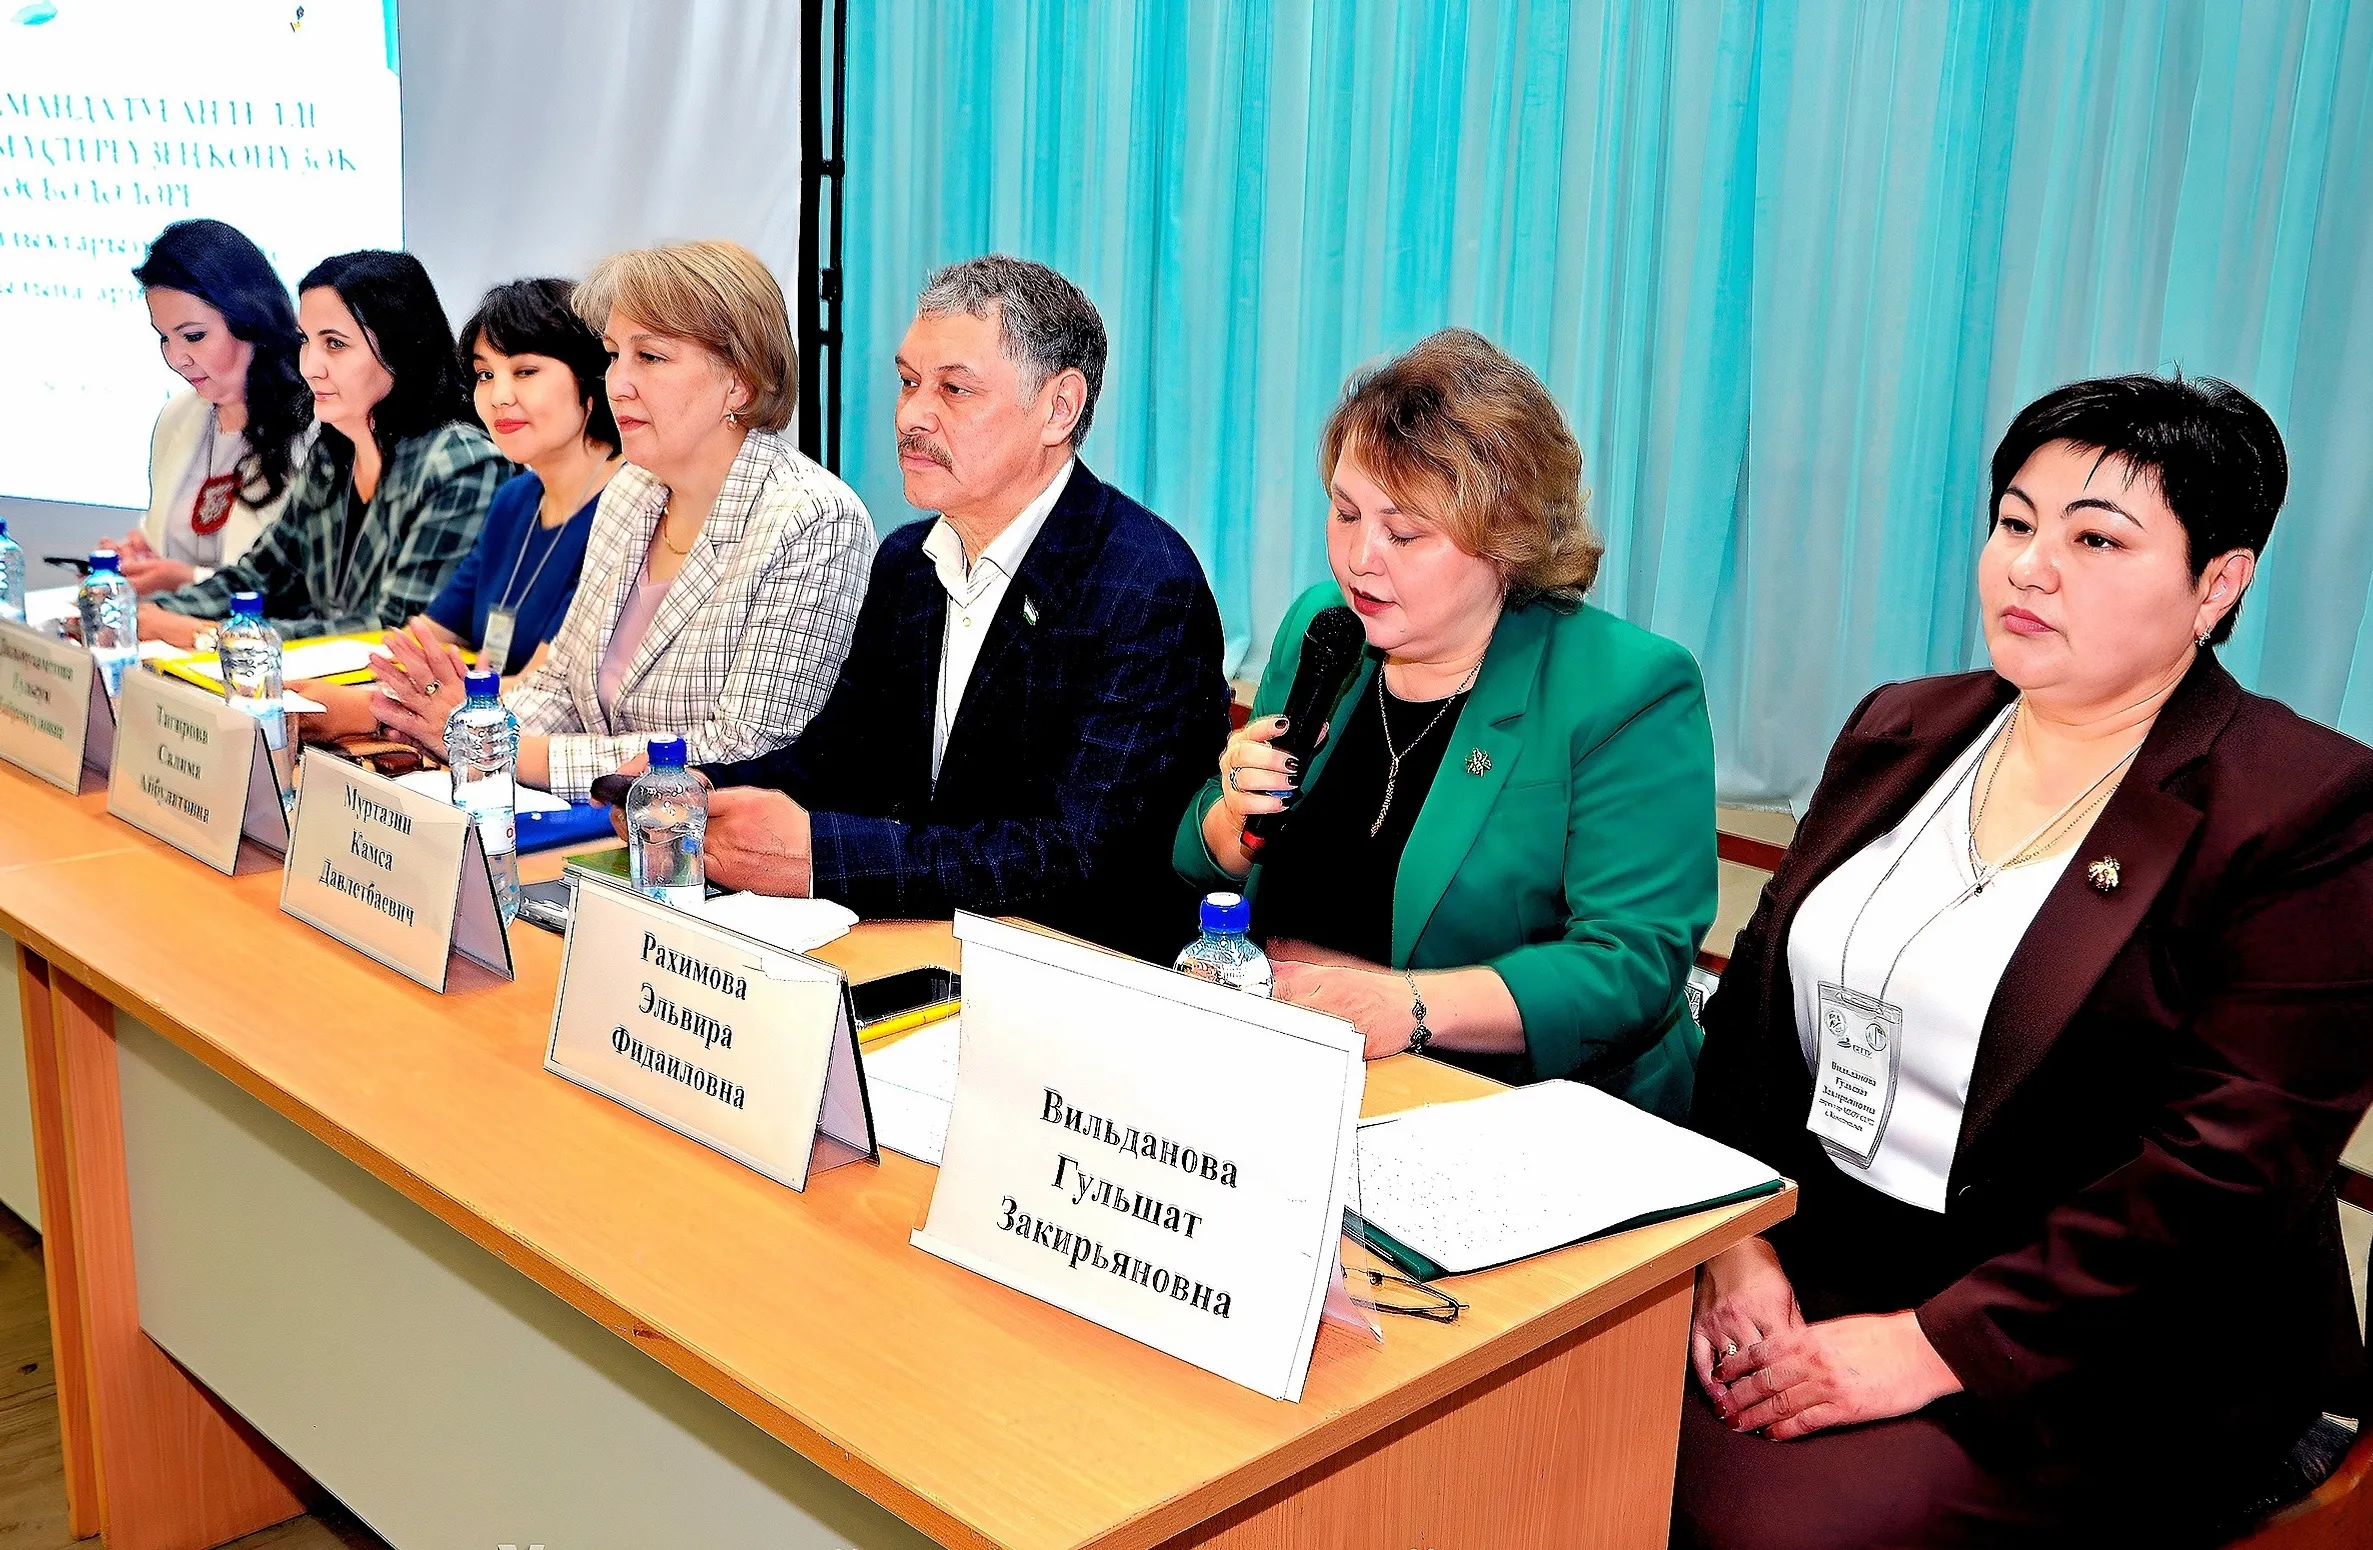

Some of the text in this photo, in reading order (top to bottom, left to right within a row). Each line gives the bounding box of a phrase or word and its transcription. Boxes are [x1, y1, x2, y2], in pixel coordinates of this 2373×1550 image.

[343, 784, 413, 836] Муртазин
[350, 829, 394, 872] Камса
[318, 859, 416, 928] Давлетбаевич
[640, 931, 748, 1001] Рахимова
[638, 982, 733, 1051] Эльвира
[611, 1025, 746, 1110] Фидаиловна
[1039, 1086, 1239, 1189] Вильданова
[1051, 1153, 1203, 1239] Гульшат
[996, 1195, 1233, 1319] Закирьяновна
